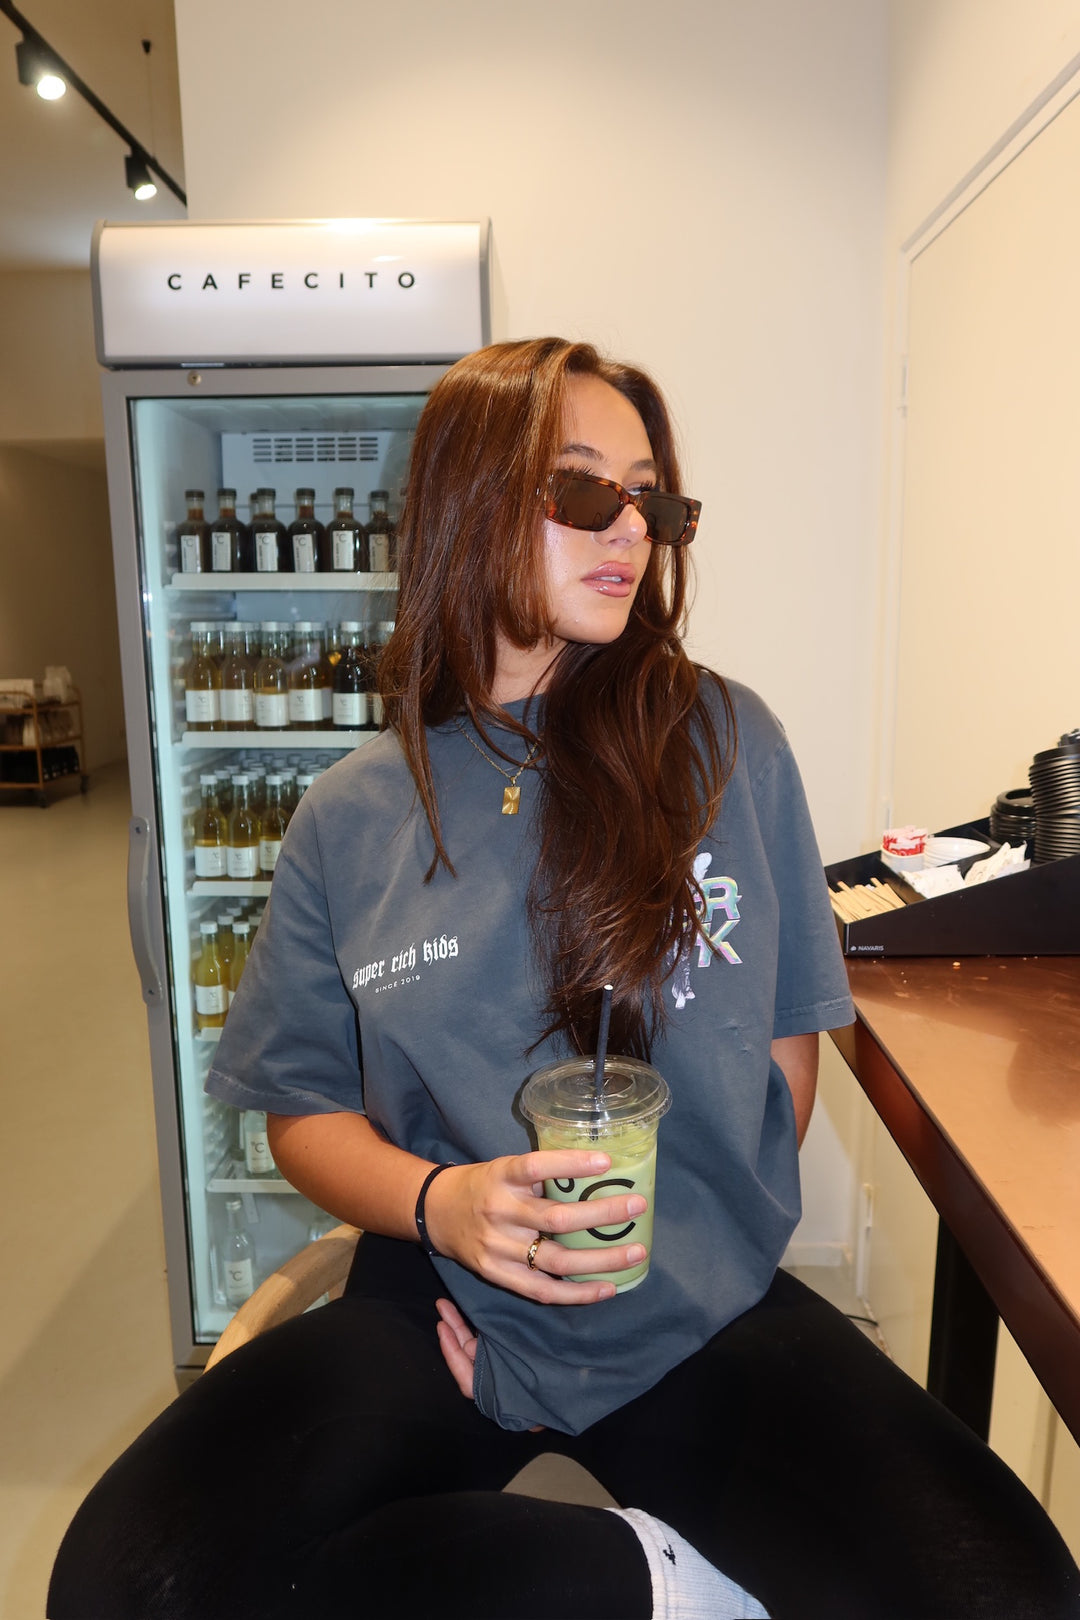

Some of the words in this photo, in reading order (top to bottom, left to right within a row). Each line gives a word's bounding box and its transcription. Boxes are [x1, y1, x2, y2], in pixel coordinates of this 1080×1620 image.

[167, 272, 415, 290] CAFECITO
[352, 960, 385, 990] super
[391, 943, 417, 972] rich
[374, 981, 398, 994] SINCE
